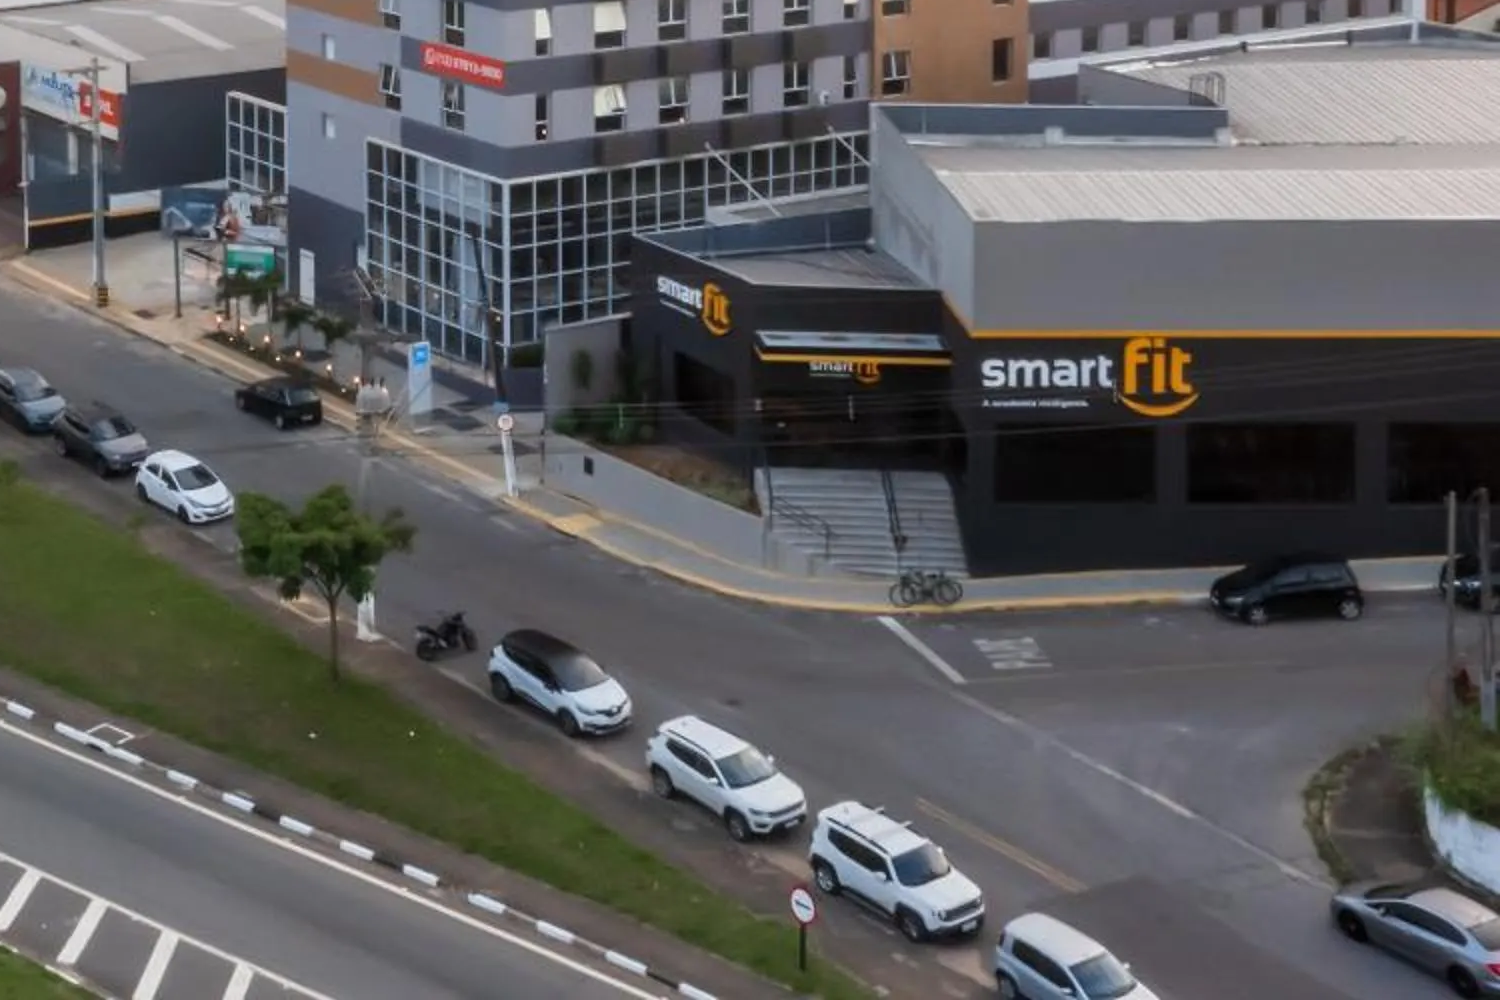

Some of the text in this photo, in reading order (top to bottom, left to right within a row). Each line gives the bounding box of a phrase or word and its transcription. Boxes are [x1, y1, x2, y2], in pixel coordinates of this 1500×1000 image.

[656, 275, 703, 309] smart
[702, 281, 731, 325] fit
[981, 337, 1194, 394] smart fit
